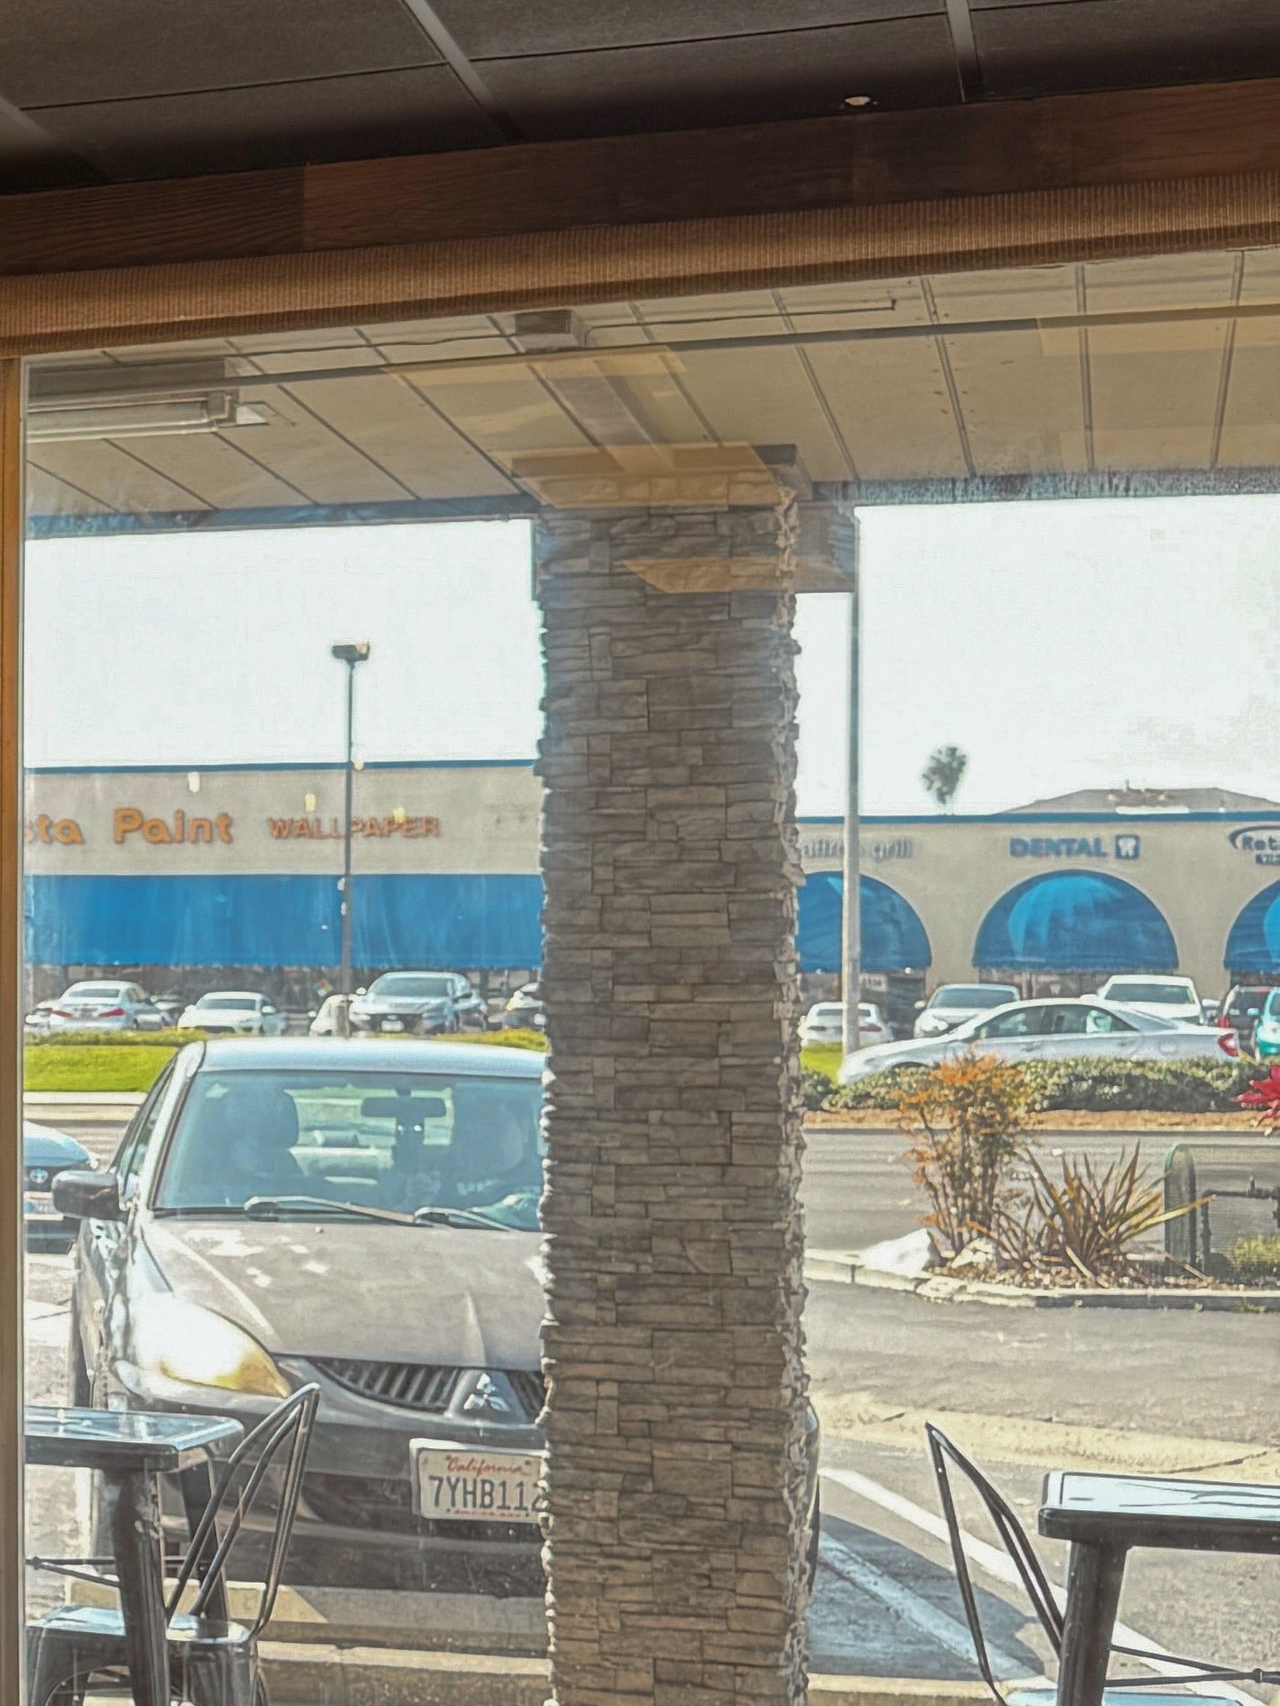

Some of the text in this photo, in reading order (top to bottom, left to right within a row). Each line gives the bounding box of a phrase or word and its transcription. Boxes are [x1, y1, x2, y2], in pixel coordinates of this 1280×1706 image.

[113, 807, 235, 844] Paint
[268, 816, 440, 839] WALLPAPER
[1009, 837, 1107, 858] DENTAL
[448, 1457, 522, 1477] California
